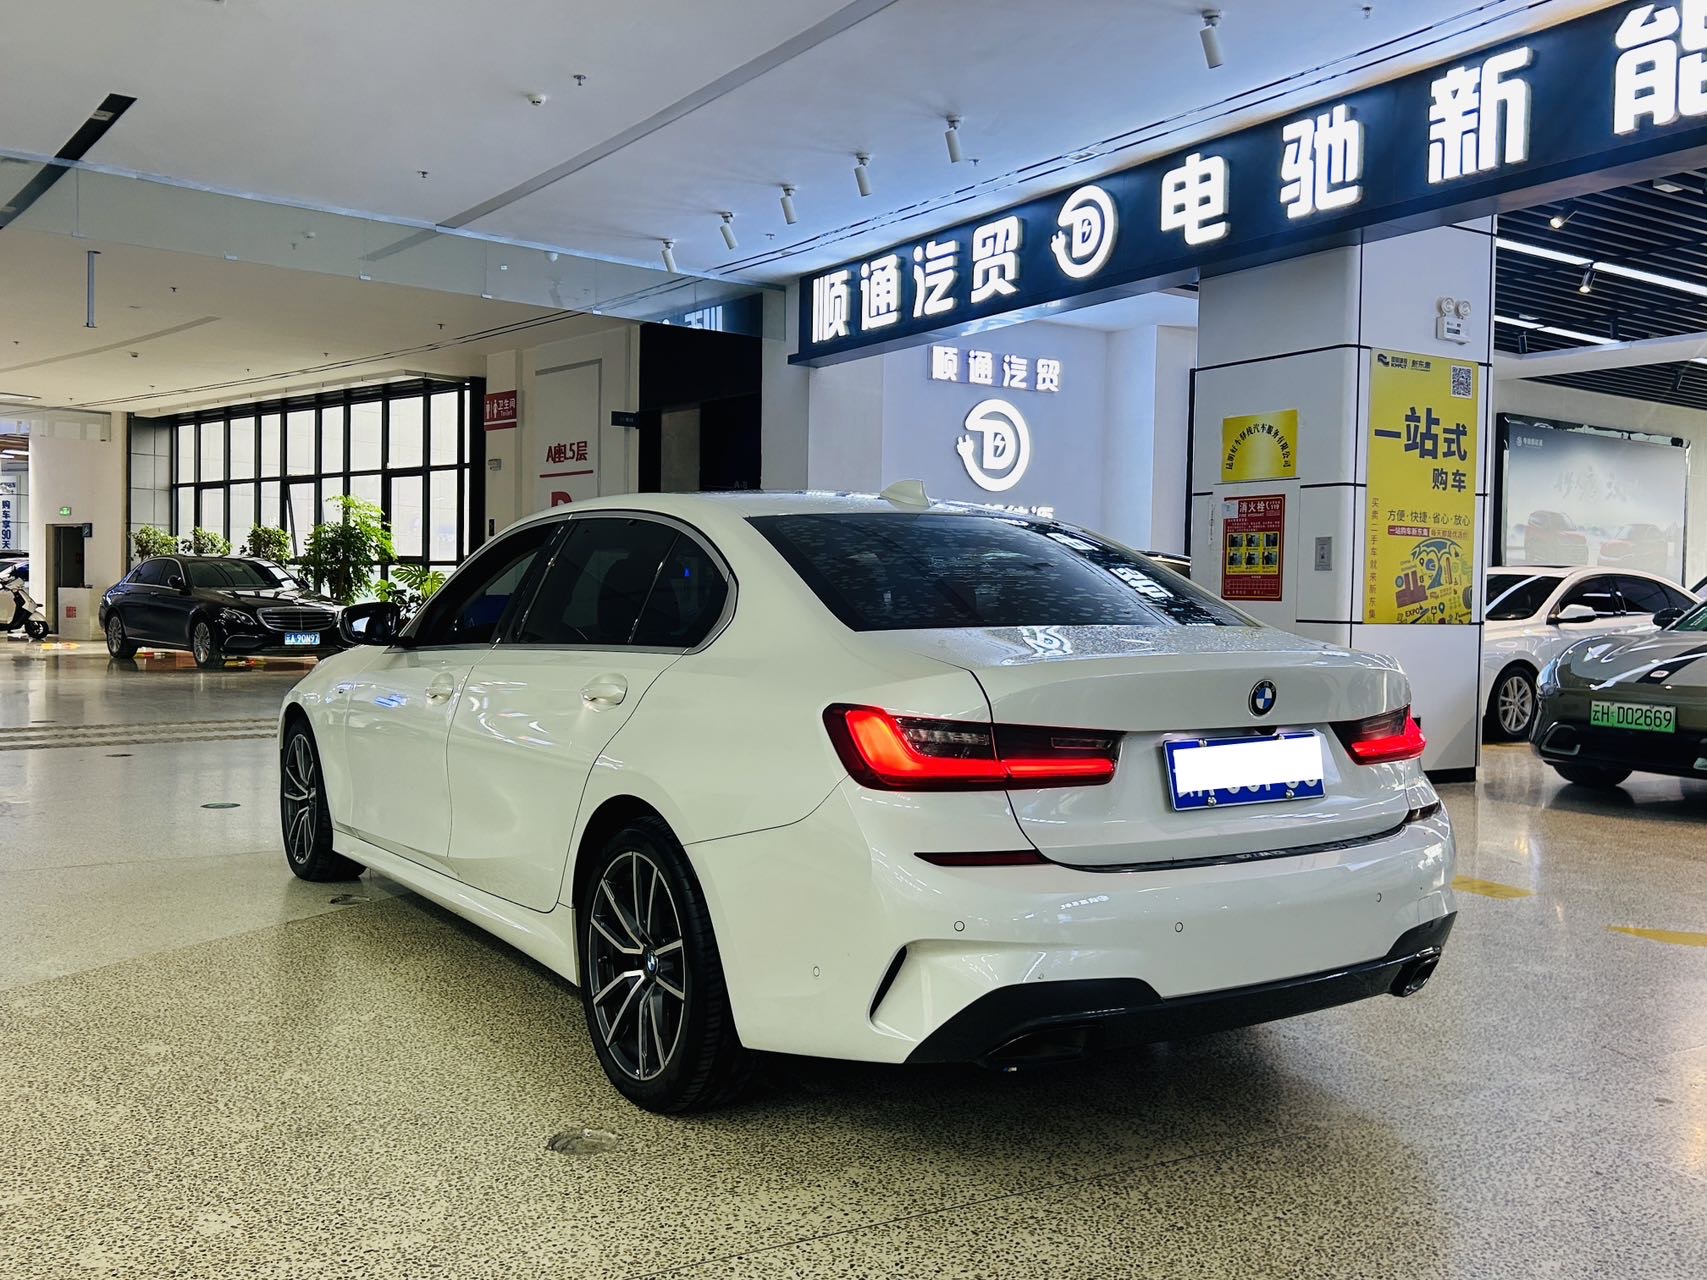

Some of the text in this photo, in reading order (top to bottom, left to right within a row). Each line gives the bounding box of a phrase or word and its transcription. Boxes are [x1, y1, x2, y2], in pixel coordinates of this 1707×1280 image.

[812, 215, 1023, 344] 顺通汽贸
[932, 345, 1060, 391] 顺通汽贸
[498, 398, 515, 411] 卫生间
[1374, 406, 1468, 461] 一站式
[546, 441, 588, 464] A座L5层
[1432, 468, 1467, 492] 购车
[1240, 501, 1265, 513] 消火栓
[1405, 607, 1420, 618] EXPO
